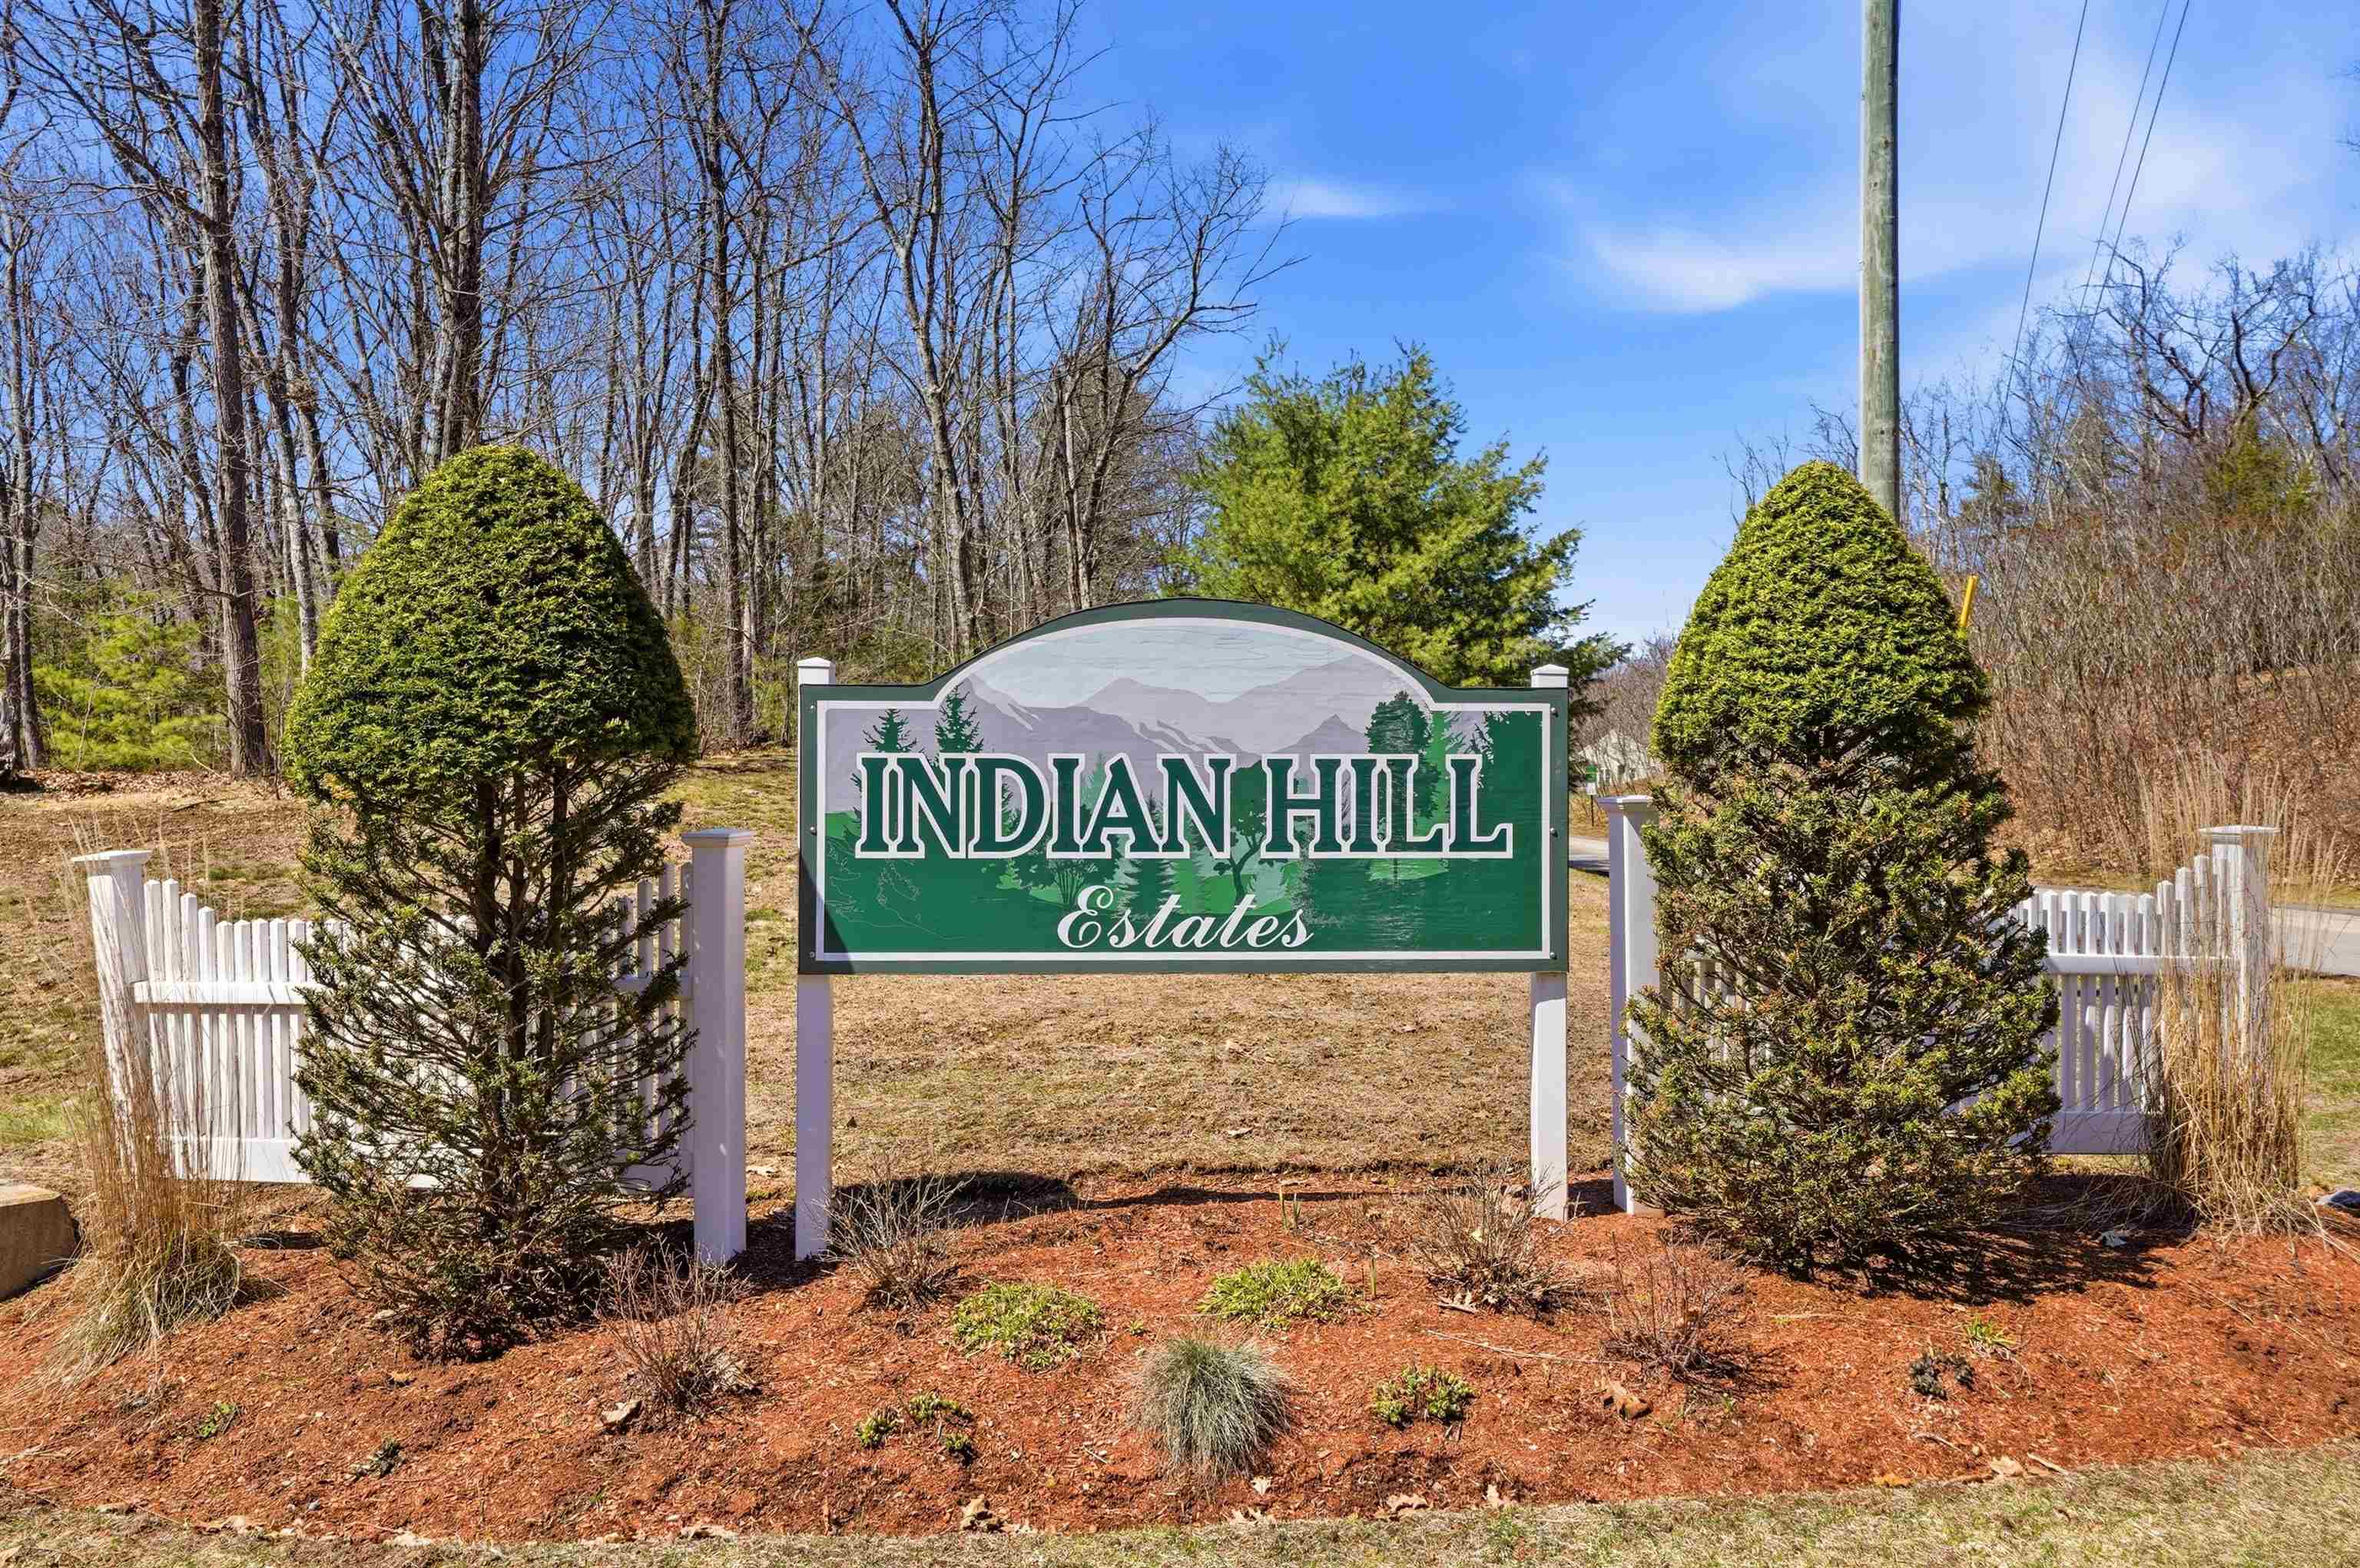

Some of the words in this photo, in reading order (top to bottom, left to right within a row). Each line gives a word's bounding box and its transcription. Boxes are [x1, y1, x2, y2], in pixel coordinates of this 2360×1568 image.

[854, 752, 1235, 859] INDIAN
[1259, 754, 1513, 860] HILL
[1056, 884, 1314, 950] Estates
